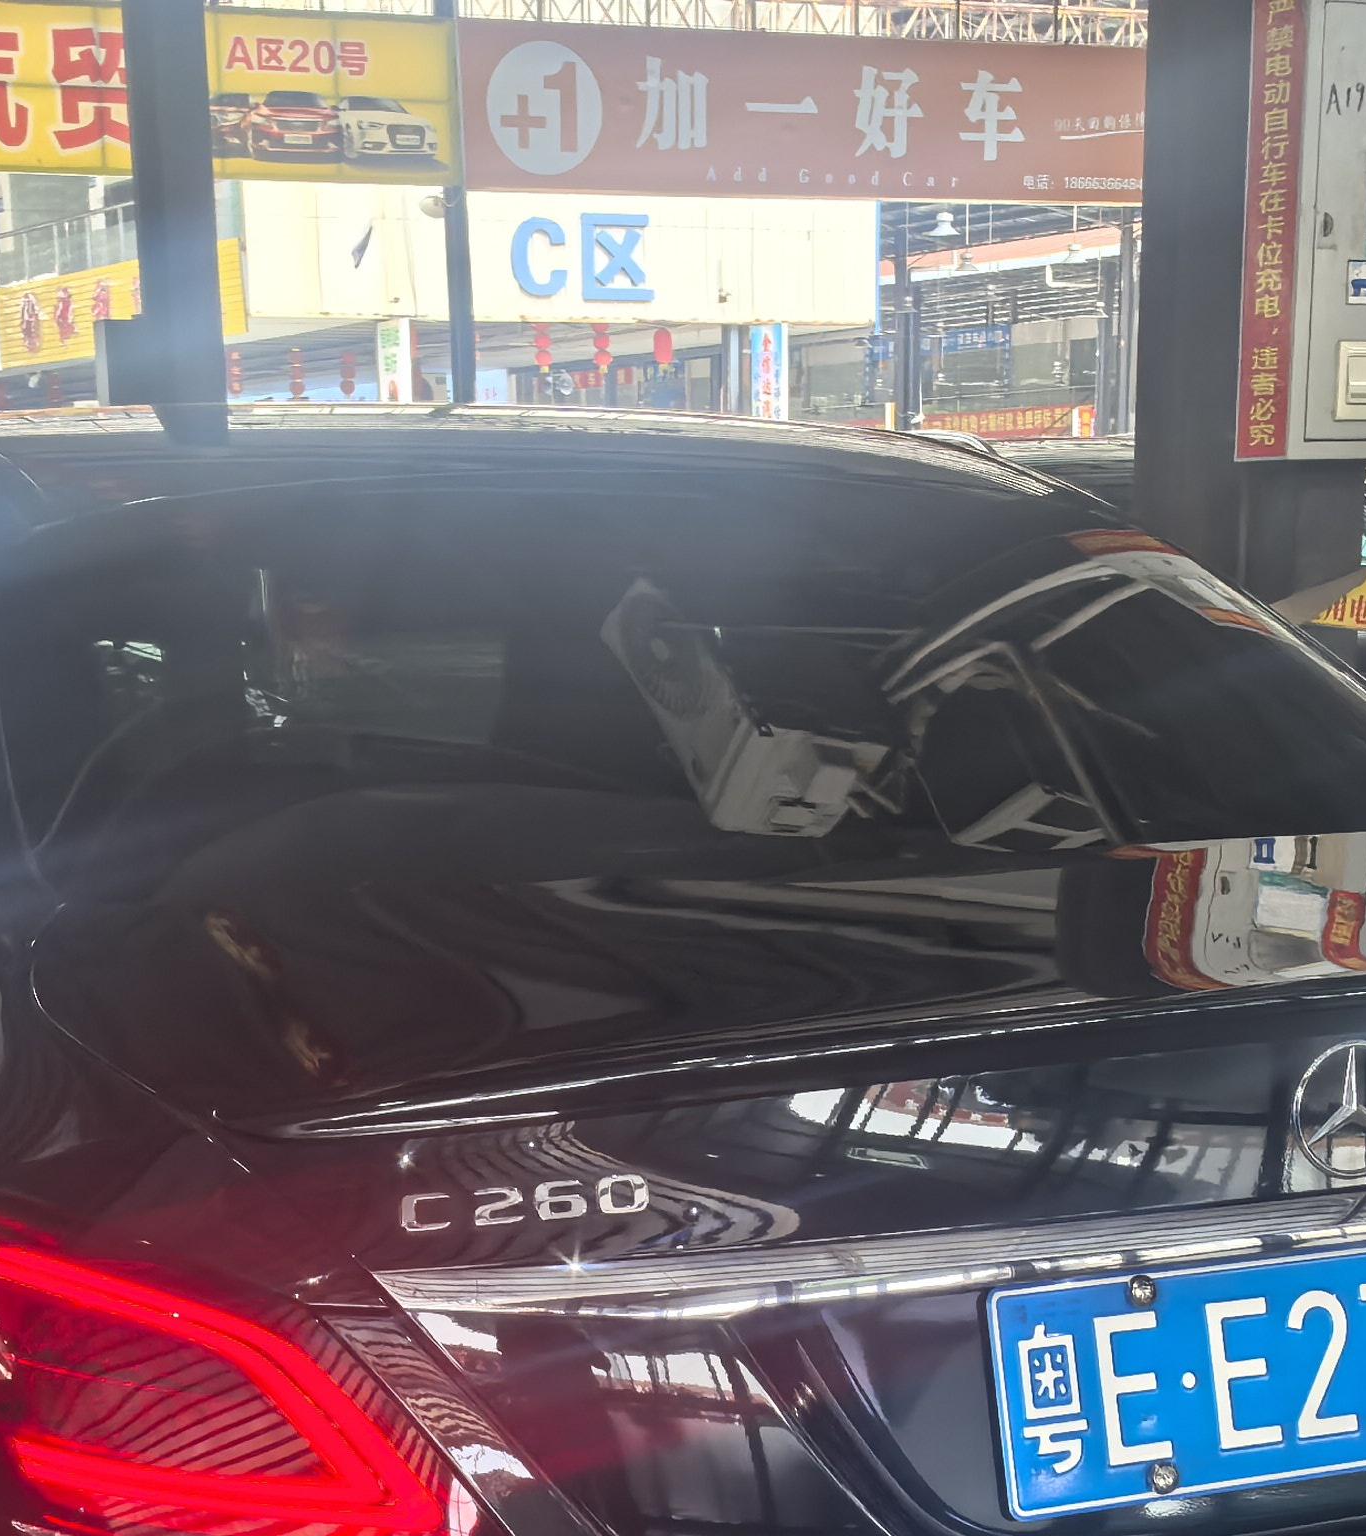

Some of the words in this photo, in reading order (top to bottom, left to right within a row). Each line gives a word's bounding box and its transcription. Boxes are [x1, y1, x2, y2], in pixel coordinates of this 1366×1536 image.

[225, 36, 368, 76] A区20号
[636, 56, 1025, 161] 加一好车
[1326, 83, 1365, 115] A19
[706, 166, 767, 183] Add
[902, 171, 959, 188] Car
[510, 213, 656, 302] C区
